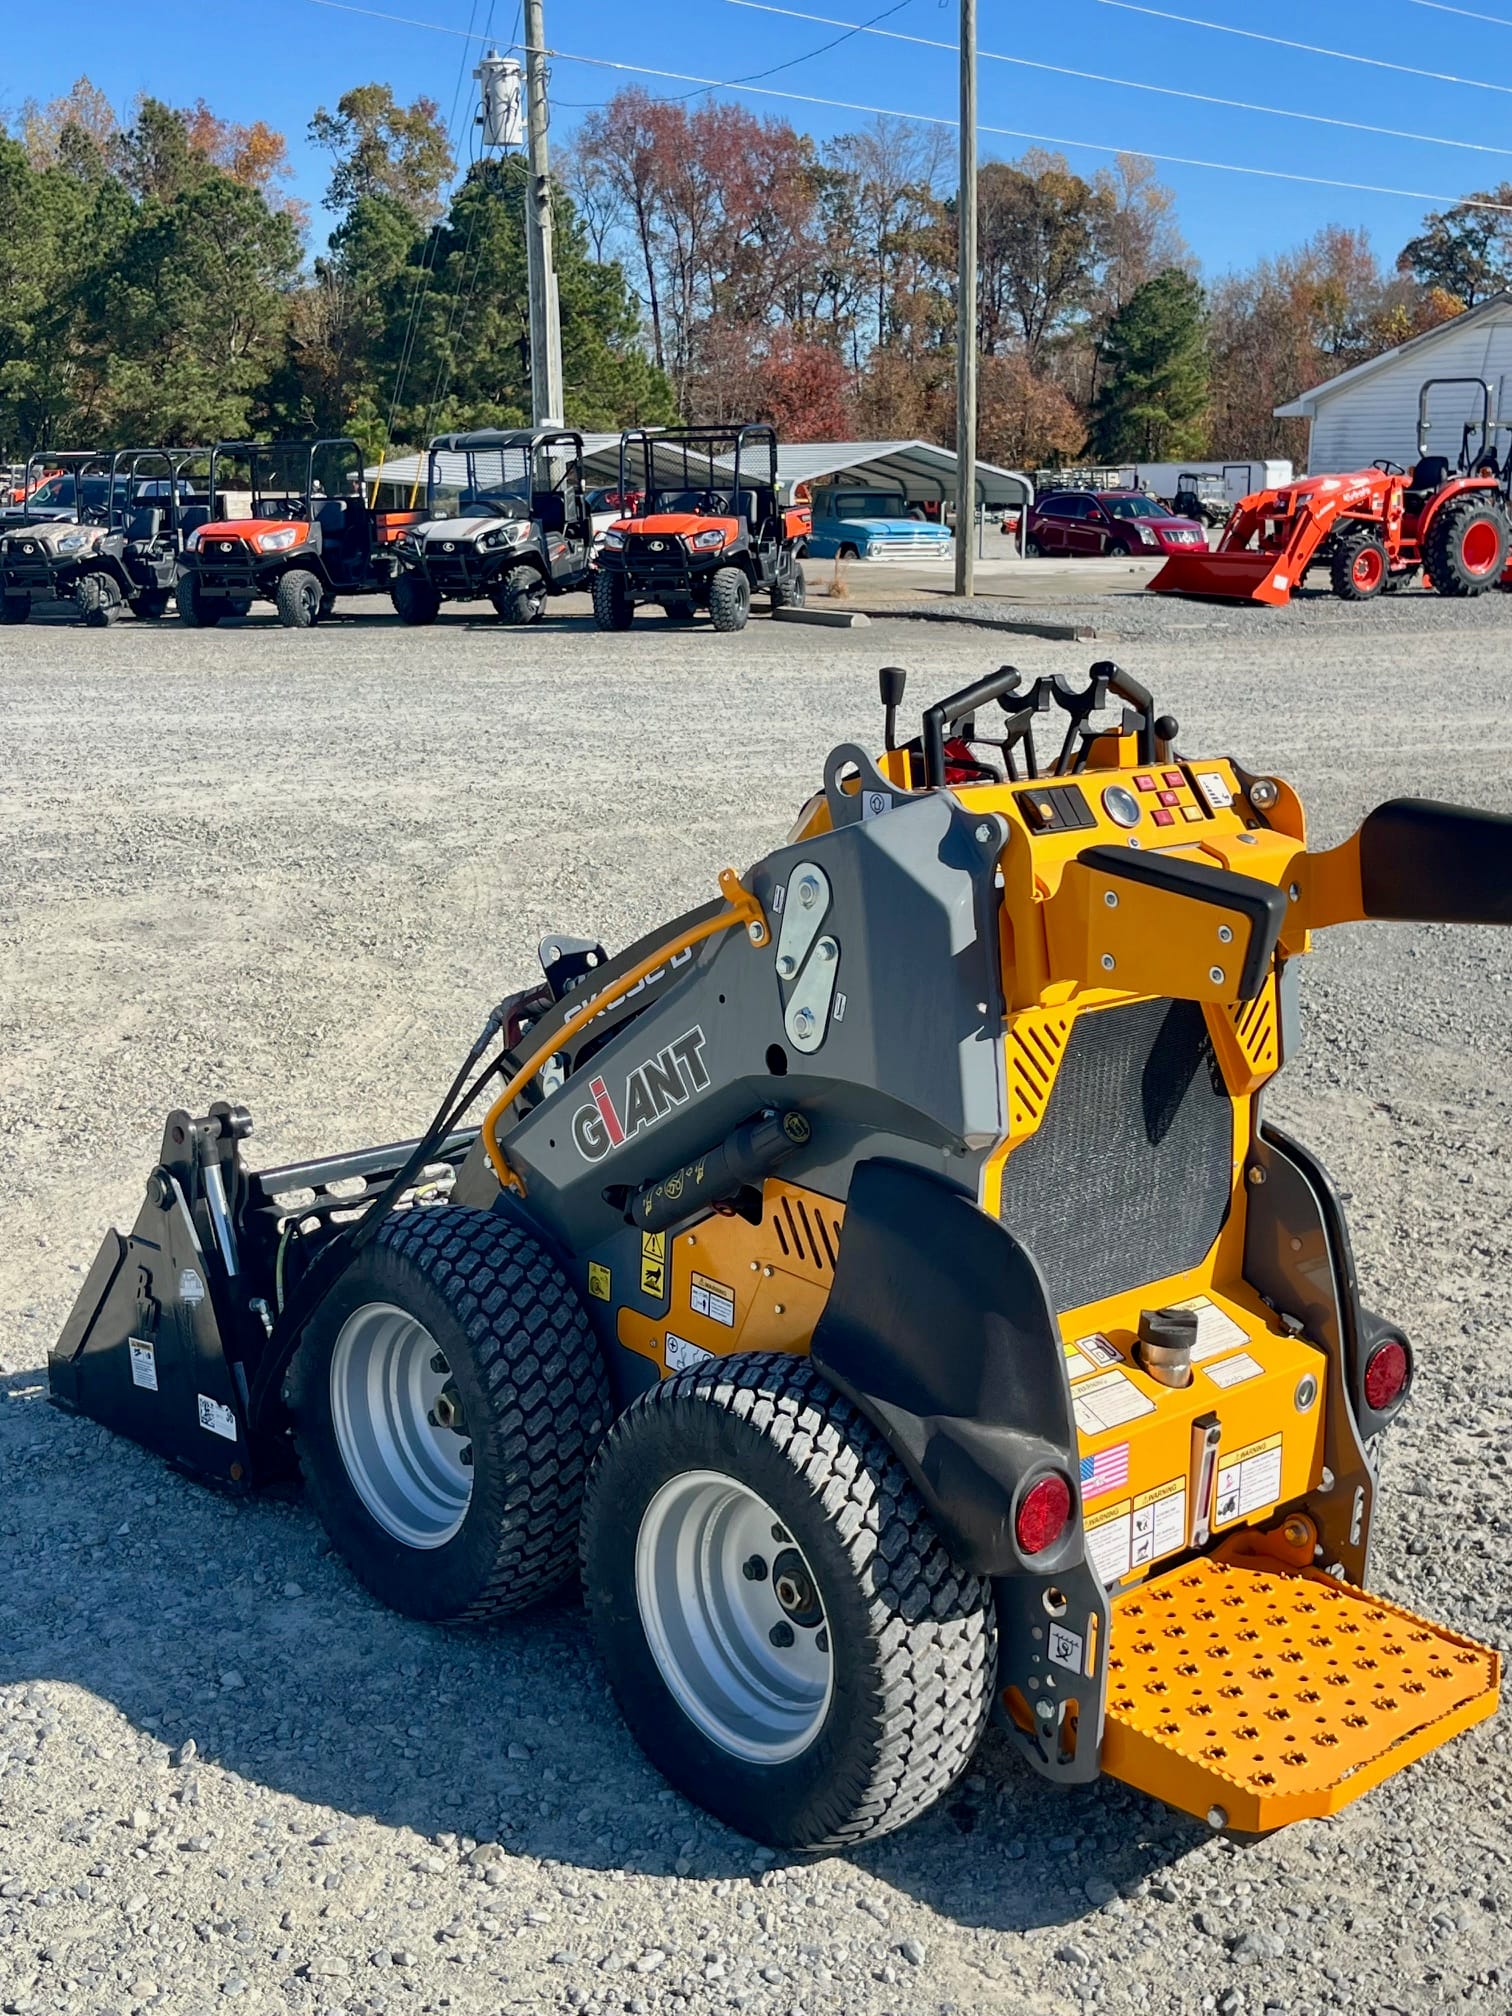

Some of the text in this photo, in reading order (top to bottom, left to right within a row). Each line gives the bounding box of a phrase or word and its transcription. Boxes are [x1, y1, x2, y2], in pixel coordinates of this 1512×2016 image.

[1240, 1442, 1267, 1459] WARNING
[1148, 1483, 1177, 1502] WARNING
[1087, 1507, 1120, 1527] WARNING
